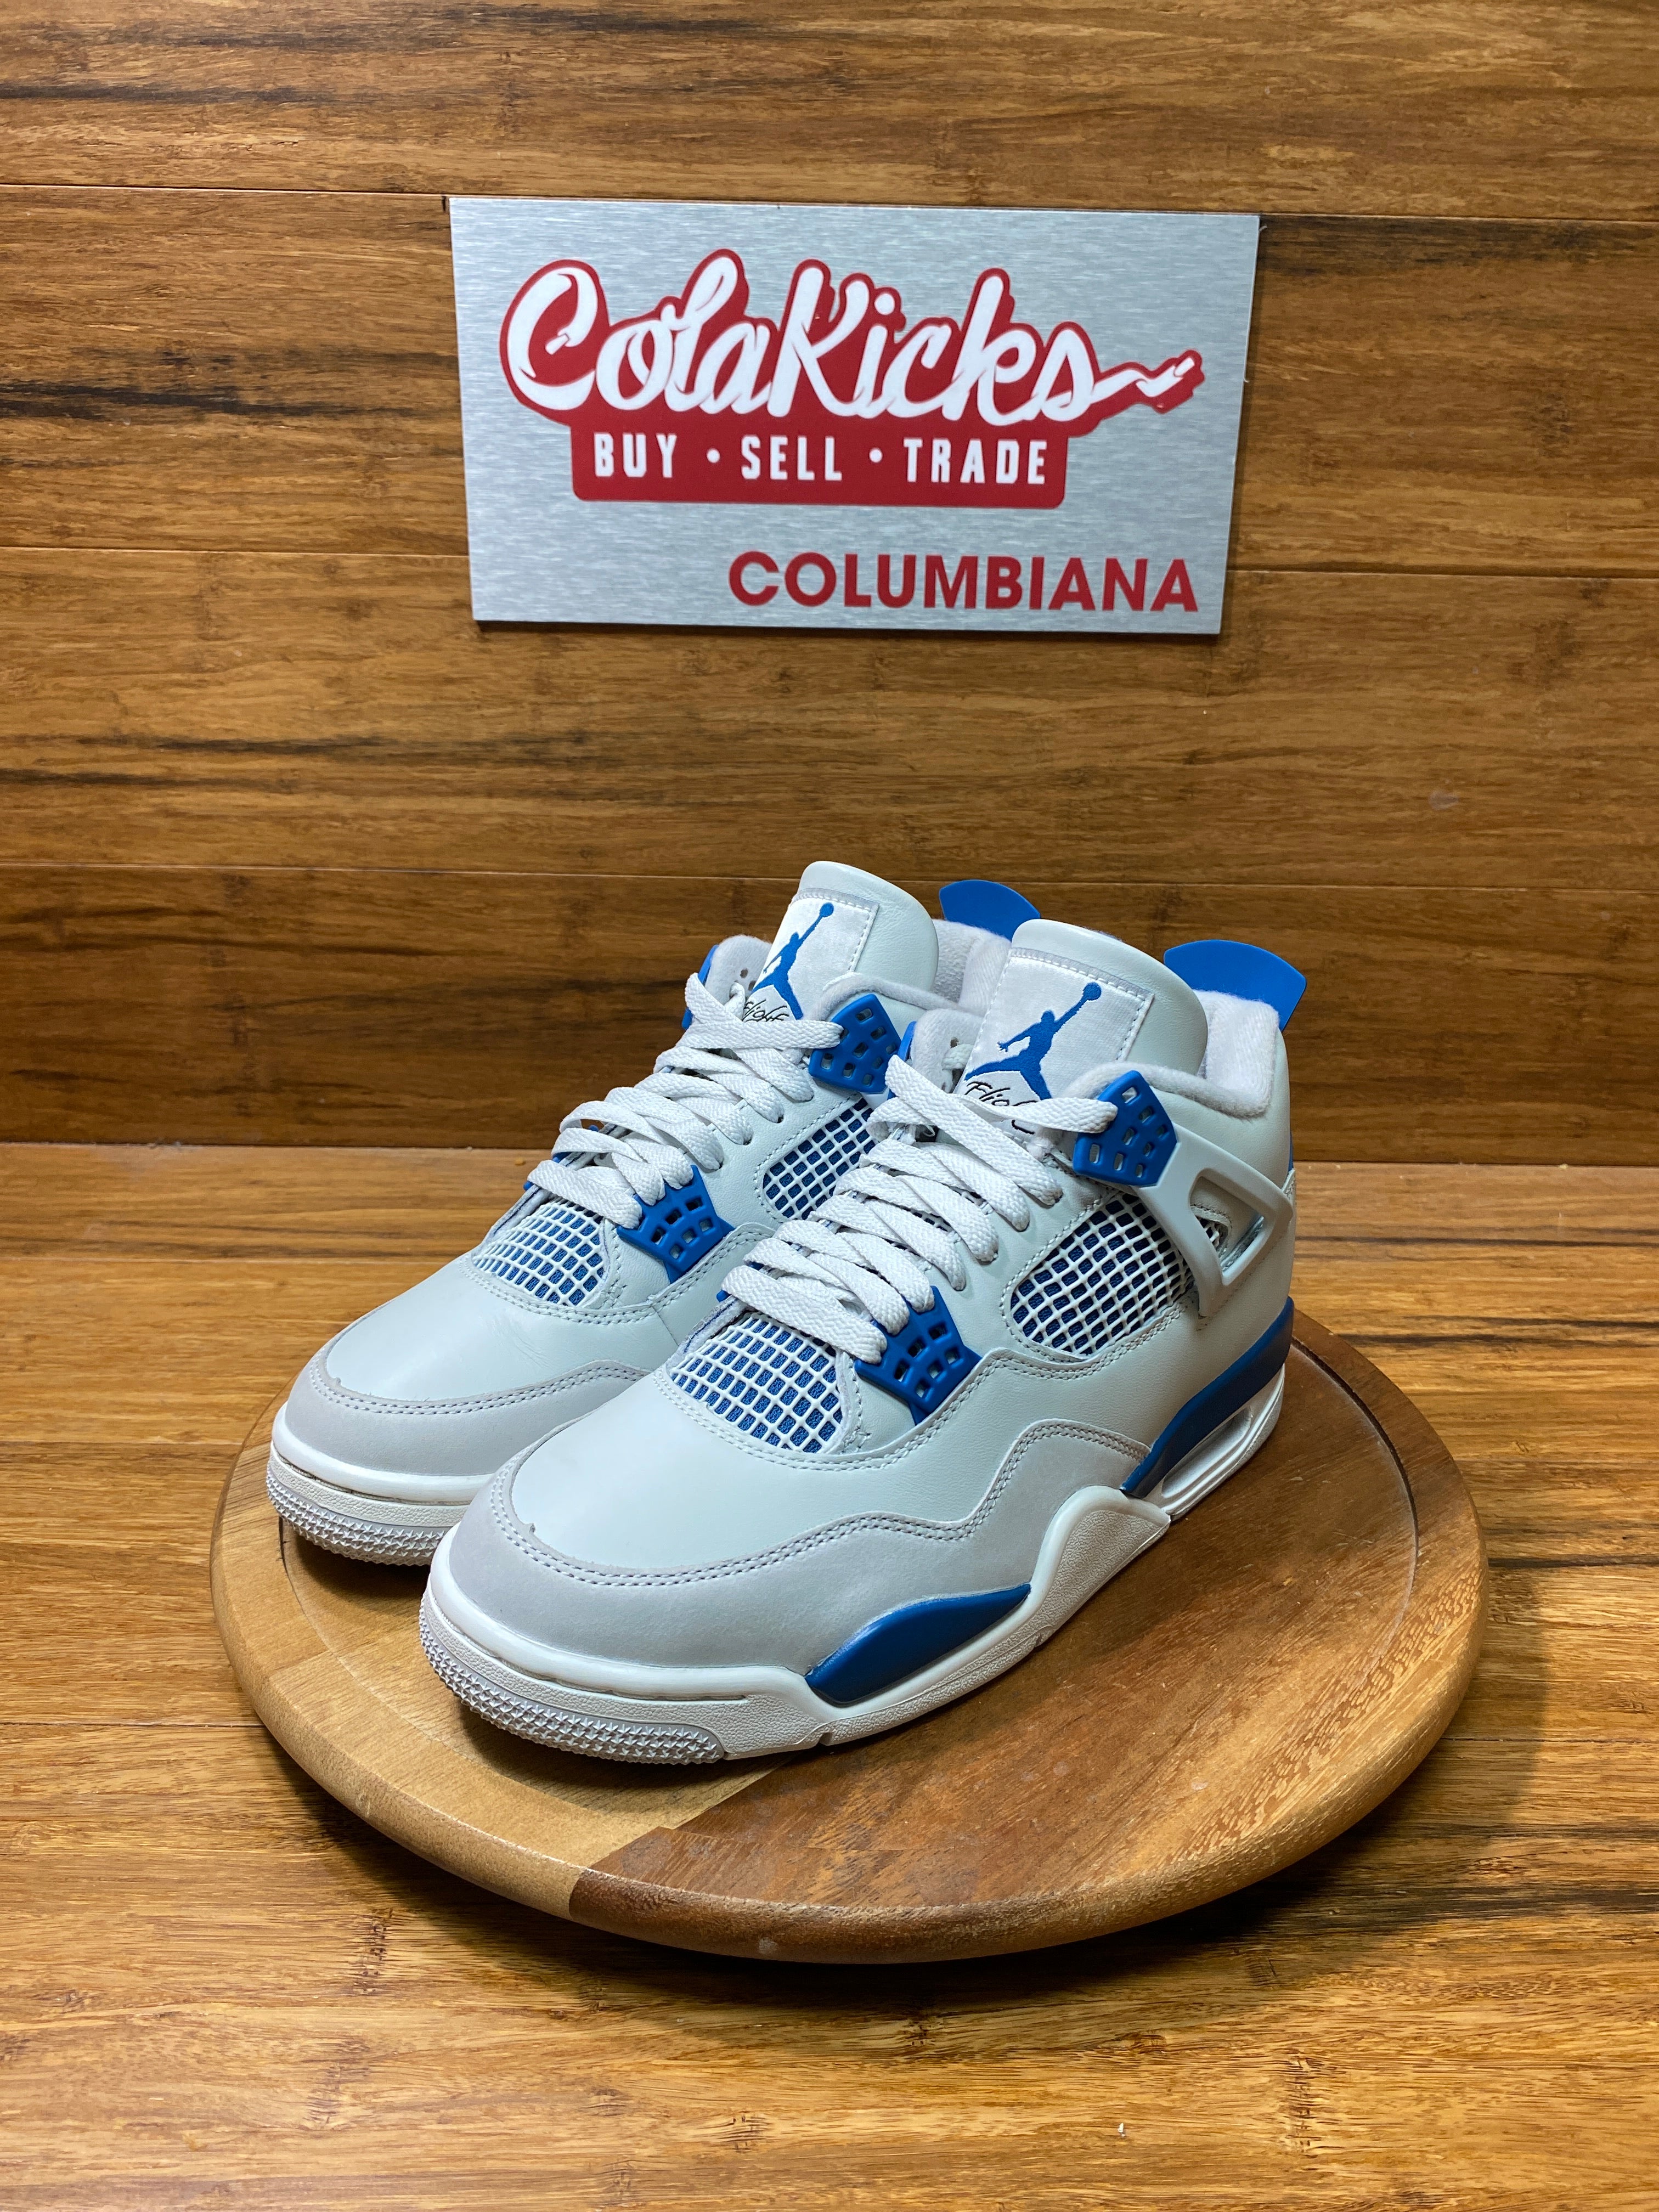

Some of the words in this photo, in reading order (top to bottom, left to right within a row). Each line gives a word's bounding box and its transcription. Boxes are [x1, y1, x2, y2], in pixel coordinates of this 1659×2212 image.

[506, 255, 1195, 427] ColaKicks
[594, 432, 678, 478] BUY
[741, 435, 843, 481] SELL
[902, 438, 1048, 485] TRADE
[728, 550, 1198, 612] COLUMBIANA
